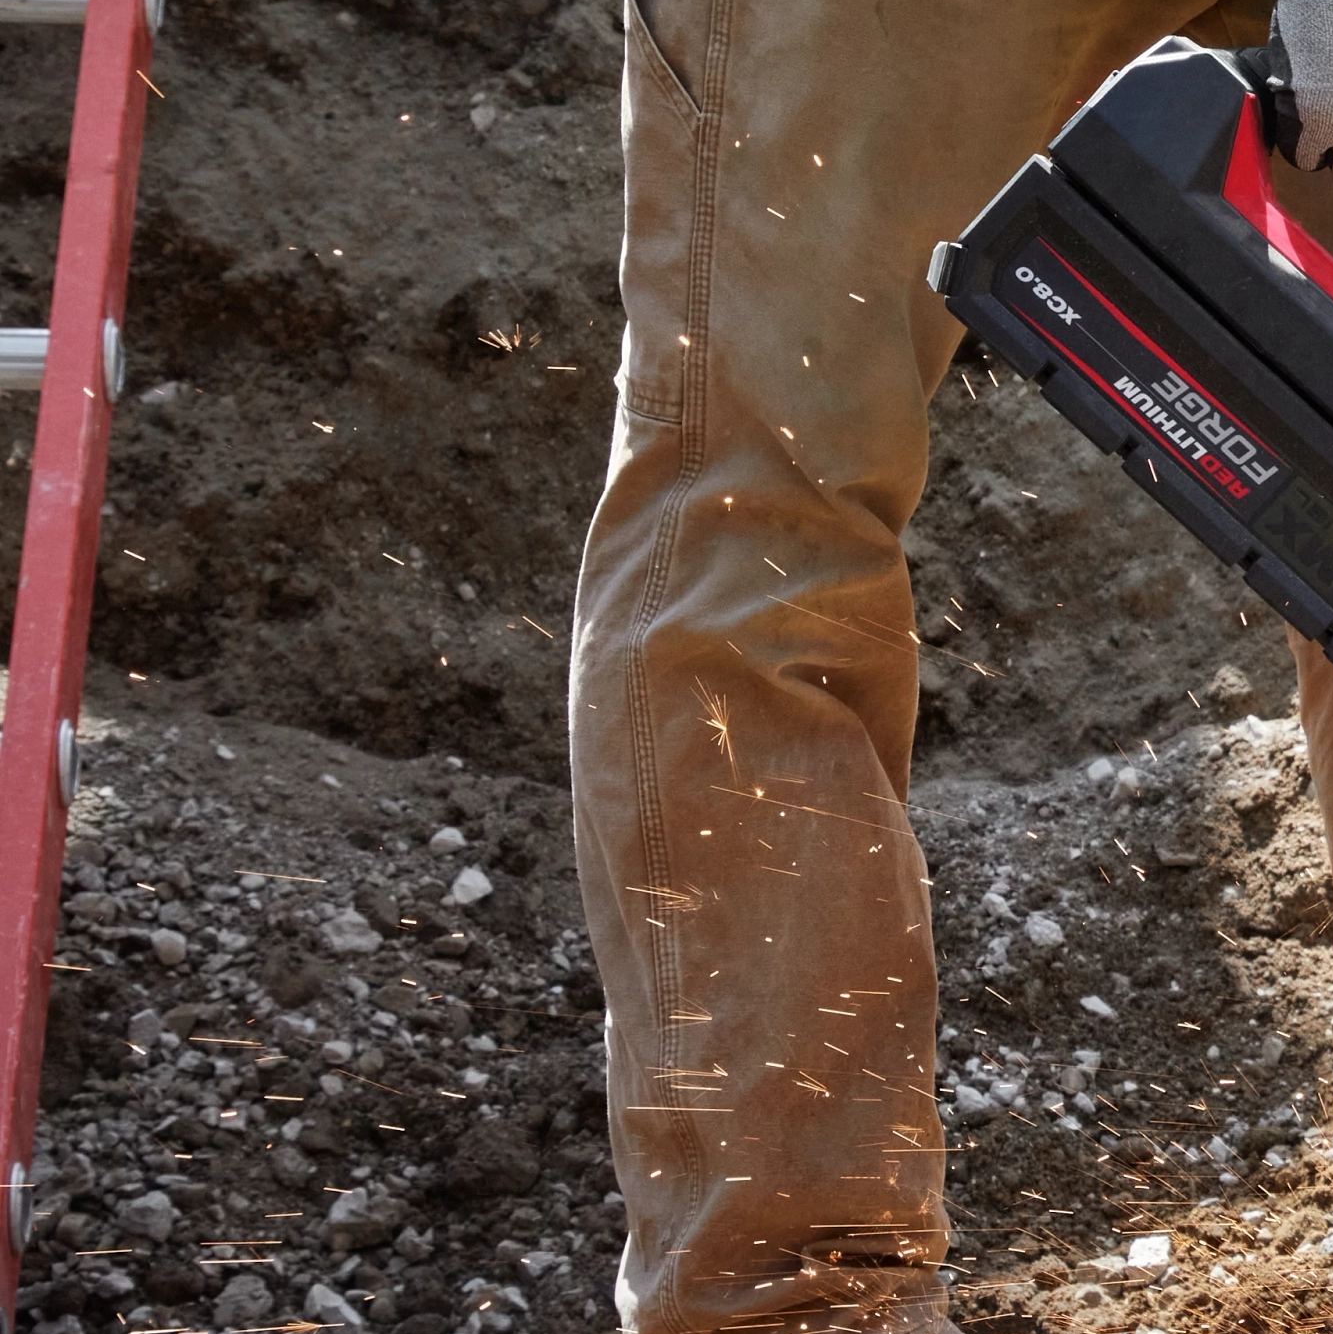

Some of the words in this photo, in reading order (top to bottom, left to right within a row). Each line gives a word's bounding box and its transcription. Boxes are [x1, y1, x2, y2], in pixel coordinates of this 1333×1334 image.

[1014, 266, 1082, 326] XC8.0
[1113, 375, 1251, 500] REDLITHIUM
[1151, 370, 1279, 485] FORGE
